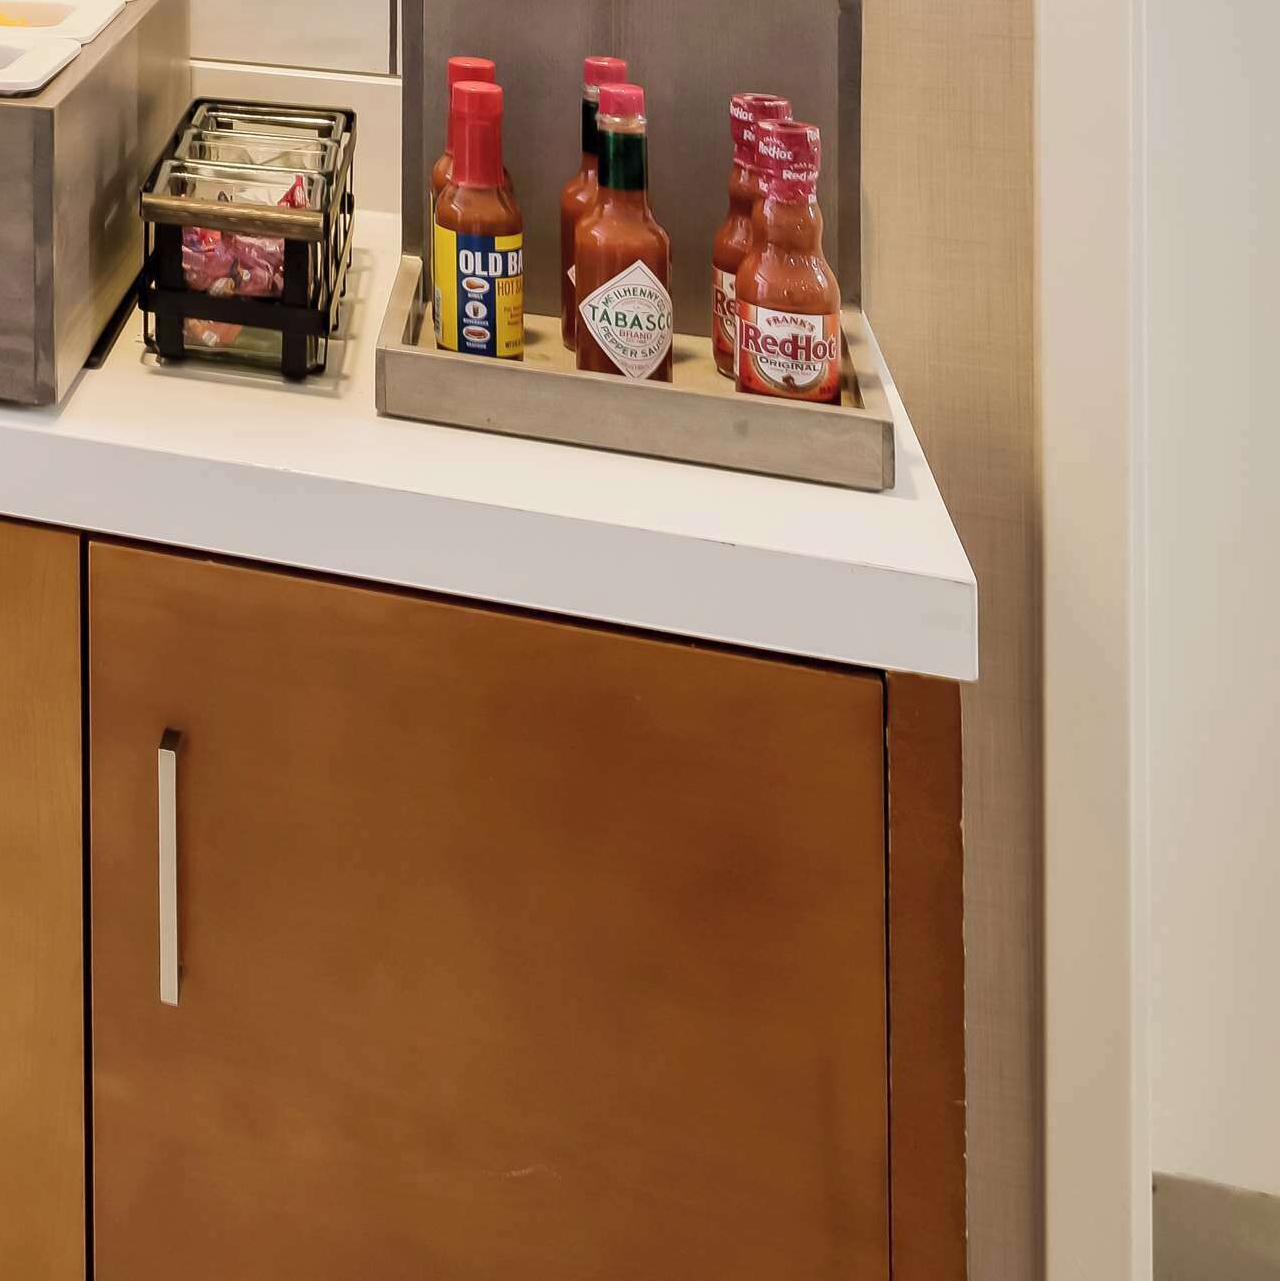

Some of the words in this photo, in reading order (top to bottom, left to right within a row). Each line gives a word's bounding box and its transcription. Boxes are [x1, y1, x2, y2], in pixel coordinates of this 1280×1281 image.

[459, 249, 503, 277] OLD
[618, 329, 654, 341] BRAND
[765, 315, 817, 333] FRANK'S
[601, 325, 639, 359] PEPPER
[741, 319, 838, 363] RedHot
[759, 355, 820, 373] ORIGINAL
